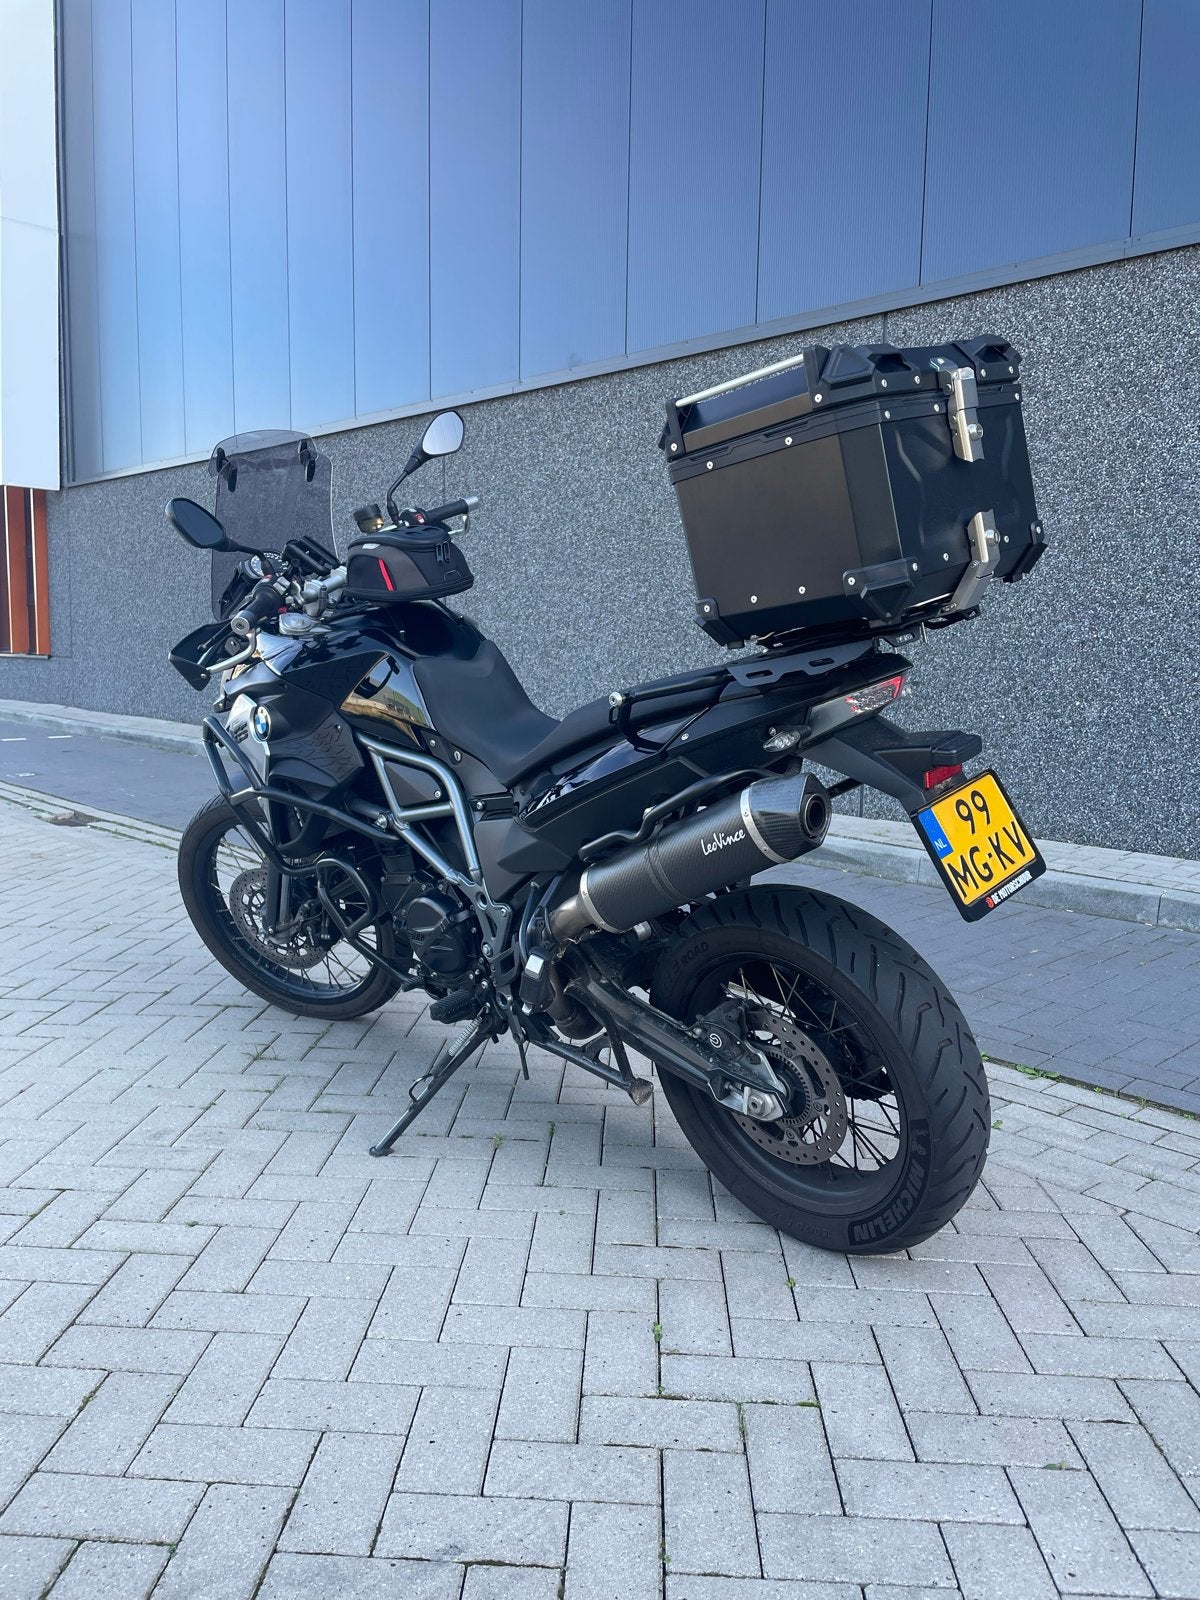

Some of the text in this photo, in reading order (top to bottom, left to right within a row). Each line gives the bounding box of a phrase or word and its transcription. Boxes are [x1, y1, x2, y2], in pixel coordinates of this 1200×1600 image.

[955, 790, 991, 835] 99
[700, 829, 746, 856] LeoVince
[934, 838, 947, 851] NL
[991, 892, 1001, 905] DE
[681, 942, 709, 966] ROAD
[853, 1159, 926, 1242] MICHELIN
